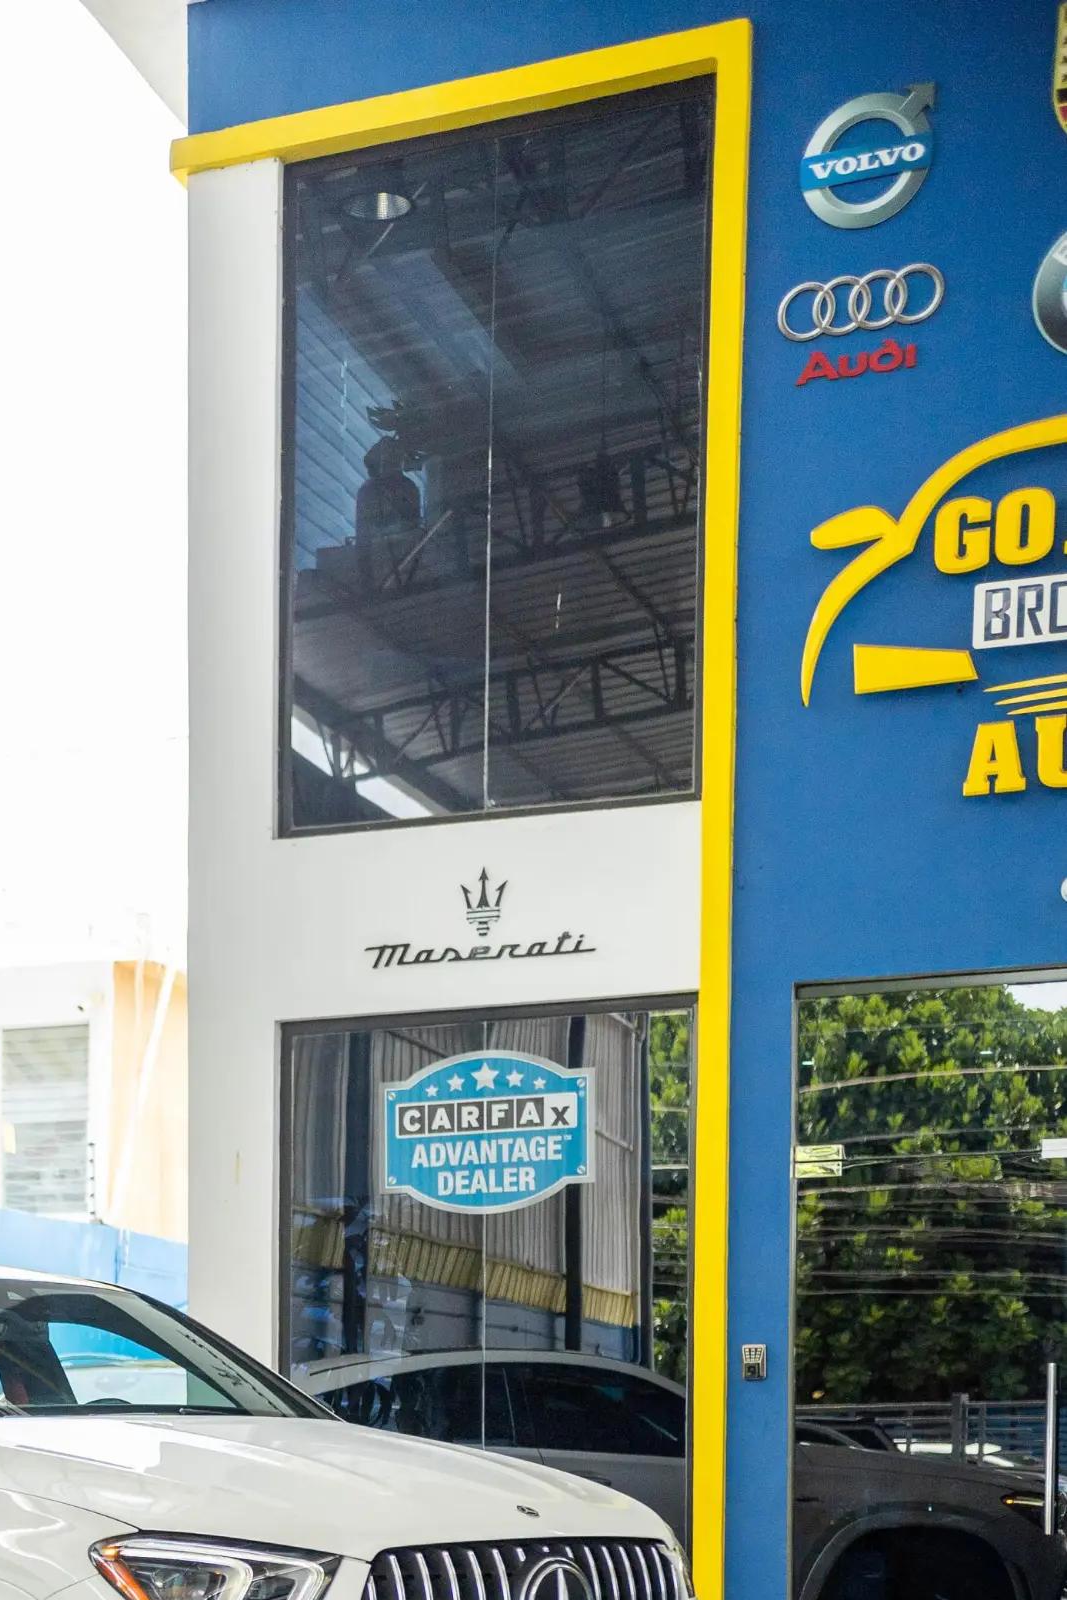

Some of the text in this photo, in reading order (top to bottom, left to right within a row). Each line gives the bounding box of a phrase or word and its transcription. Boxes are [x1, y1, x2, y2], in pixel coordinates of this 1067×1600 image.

[808, 142, 926, 180] VOLVO
[934, 486, 1067, 575] GO
[364, 931, 596, 969] Maserati
[402, 1101, 571, 1133] CARFAX
[437, 1166, 536, 1197] DEALER
